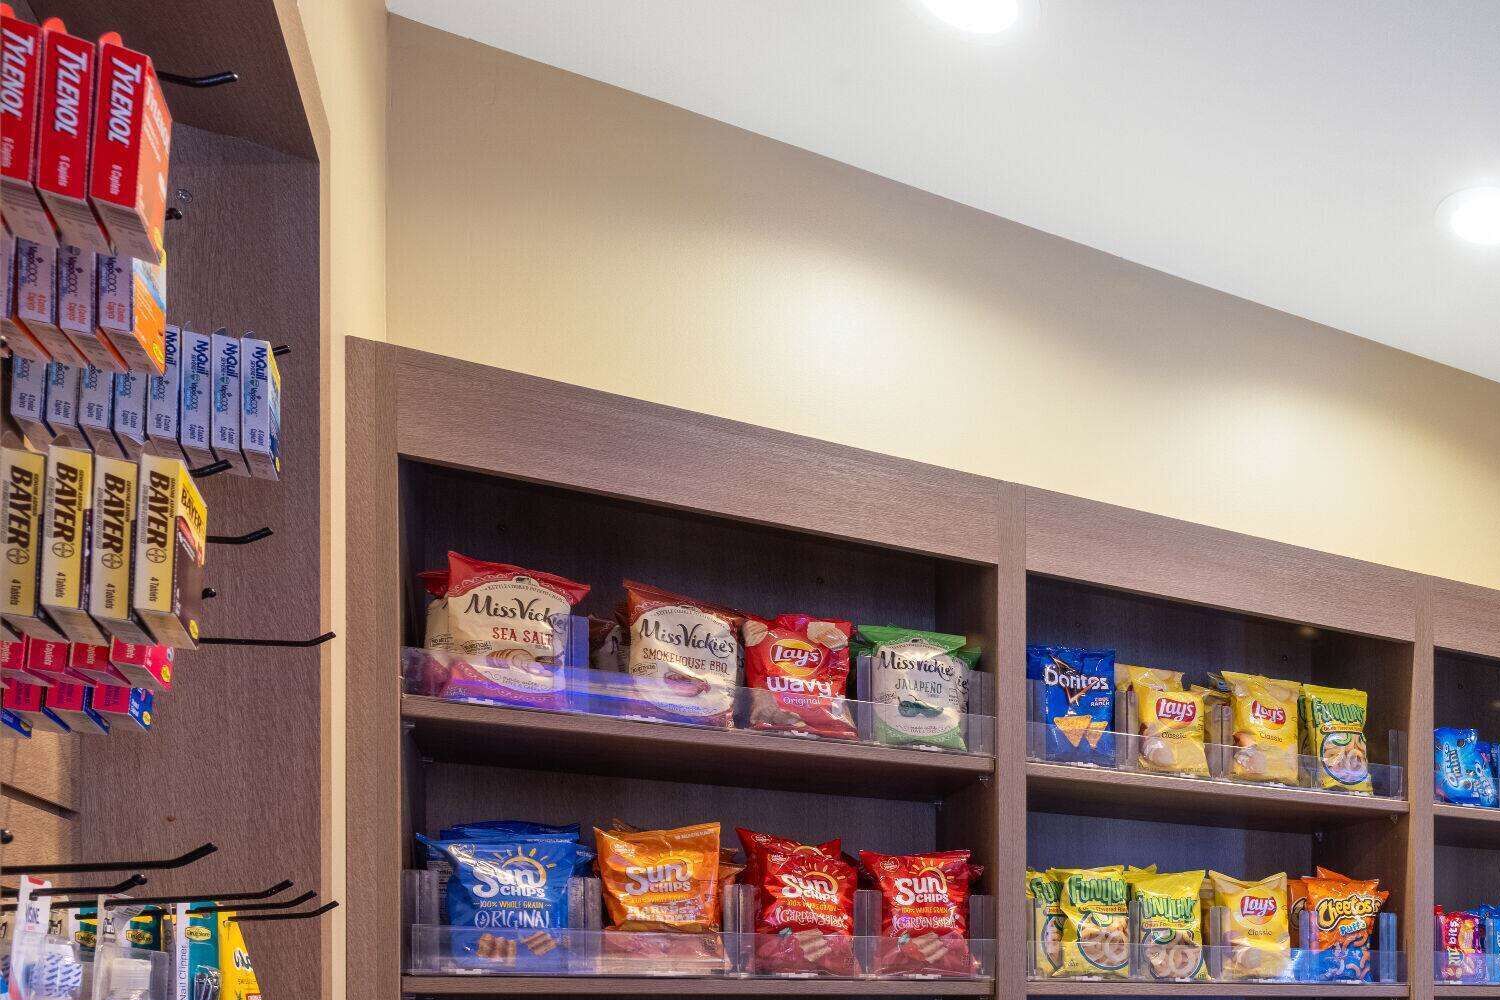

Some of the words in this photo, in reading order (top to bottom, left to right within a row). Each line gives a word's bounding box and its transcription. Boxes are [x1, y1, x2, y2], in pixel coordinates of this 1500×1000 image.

[0, 28, 34, 119] TYLENOL
[54, 45, 88, 136] TYLENOL
[108, 57, 142, 146] TYLENOL
[58, 160, 70, 187] Caplets
[110, 170, 122, 195] Caplets
[194, 340, 209, 374] NyQuil
[223, 343, 238, 377] NyQuil
[252, 347, 267, 381] NyQuil
[7, 464, 33, 550] BAYER
[53, 462, 78, 543] BAYER
[102, 472, 125, 554] BAYER
[147, 470, 169, 549] BAYER
[180, 488, 202, 529] BAYER
[10, 585, 21, 605] Tablets
[55, 578, 66, 598] Tablets
[105, 590, 114, 609] Tablets
[149, 583, 158, 602] Tablets
[464, 593, 518, 620] Miss
[492, 627, 517, 642] SEA
[523, 629, 553, 645] SALT
[639, 618, 681, 643] Miss
[678, 622, 735, 658] Vickie's
[643, 649, 706, 671] SMOKEHOUSE
[709, 660, 729, 675] BBQ
[773, 645, 821, 667] Lay's
[880, 650, 915, 671] Miss
[767, 675, 833, 697] wavy
[895, 677, 942, 694] JALAPEÑO
[1044, 664, 1109, 690] Doritos
[783, 696, 822, 705] Original
[1158, 699, 1195, 722] Lay's
[1161, 731, 1187, 741] Classic
[472, 866, 547, 898] Sun
[500, 885, 545, 898] CHIPS
[624, 864, 691, 896] Sun
[649, 881, 691, 892] CHIPS
[896, 876, 946, 905] Sun
[499, 900, 522, 908] WHOLE
[916, 893, 948, 903] CHIPS
[1243, 896, 1276, 917] Lay's
[1317, 894, 1375, 929] Cheetos
[1248, 929, 1273, 937] Classic
[1339, 921, 1366, 936] Puffs
[178, 945, 188, 983] Clipper
